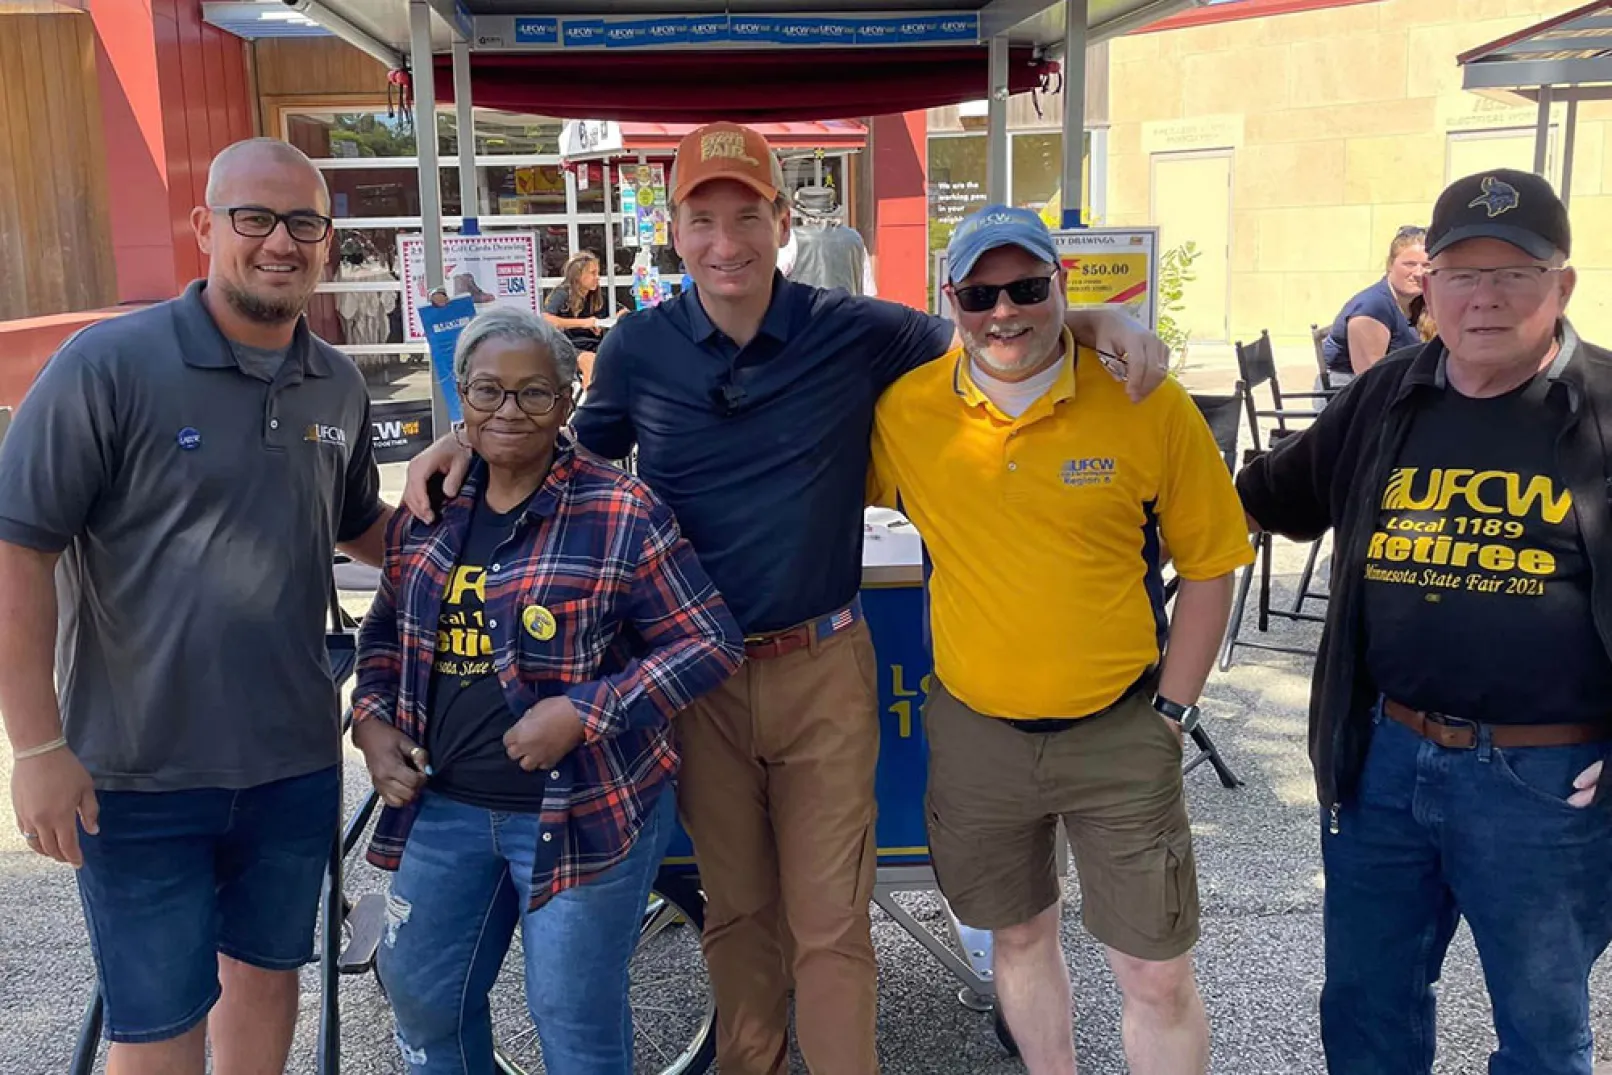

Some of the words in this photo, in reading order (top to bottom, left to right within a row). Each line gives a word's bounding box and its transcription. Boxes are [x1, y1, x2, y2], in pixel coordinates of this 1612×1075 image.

[1068, 236, 1115, 245] DRAWINGS
[1081, 263, 1129, 276] $50.00
[508, 277, 526, 293] USA
[1070, 458, 1116, 472] UFCW
[1382, 468, 1573, 524] UFCW
[1386, 517, 1447, 533] Local
[1454, 517, 1524, 539] 1189
[1367, 532, 1556, 575] Retiree
[1364, 564, 1417, 584] Minnesota
[1418, 569, 1461, 588] State
[1466, 574, 1503, 594] Fair
[1505, 577, 1545, 596] 2021
